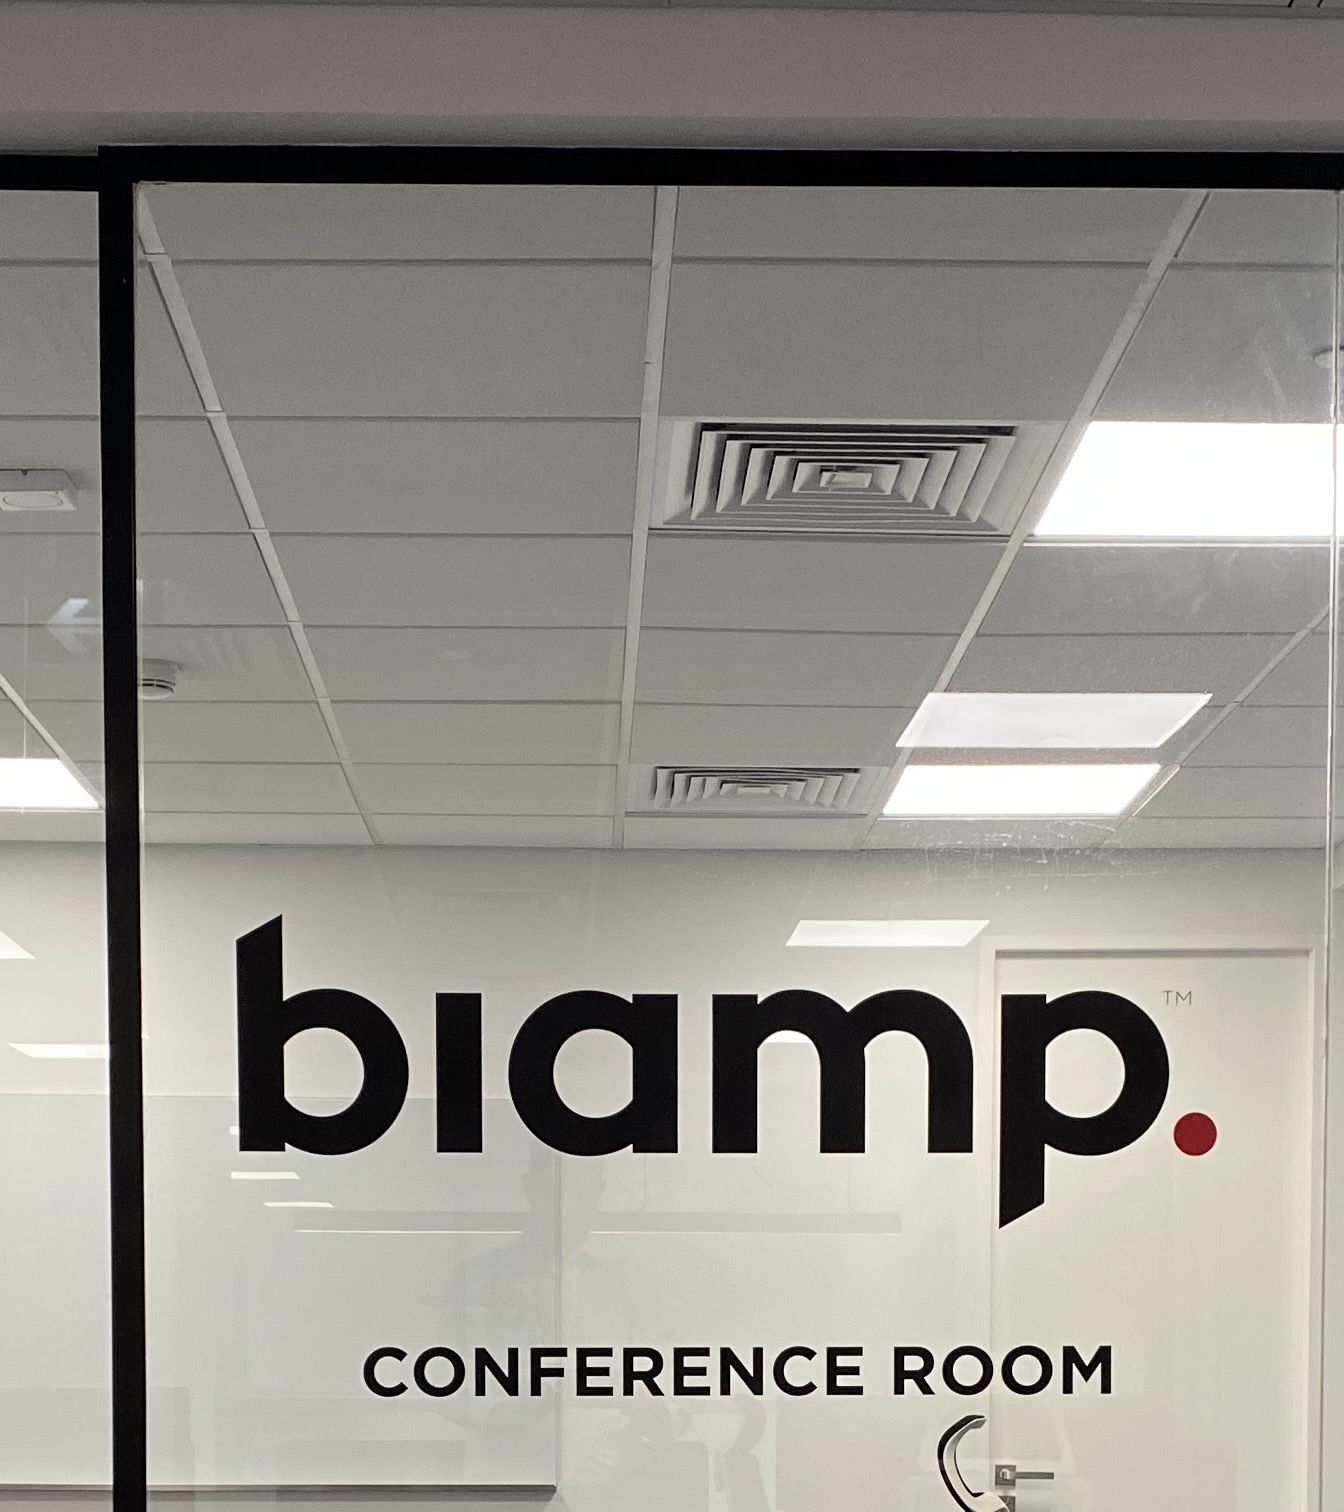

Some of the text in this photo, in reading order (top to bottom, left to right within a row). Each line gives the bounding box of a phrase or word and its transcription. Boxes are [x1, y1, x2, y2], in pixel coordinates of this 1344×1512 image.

[1162, 990, 1192, 1006] TM
[363, 1345, 1112, 1398] CONFERENCE ROOM
